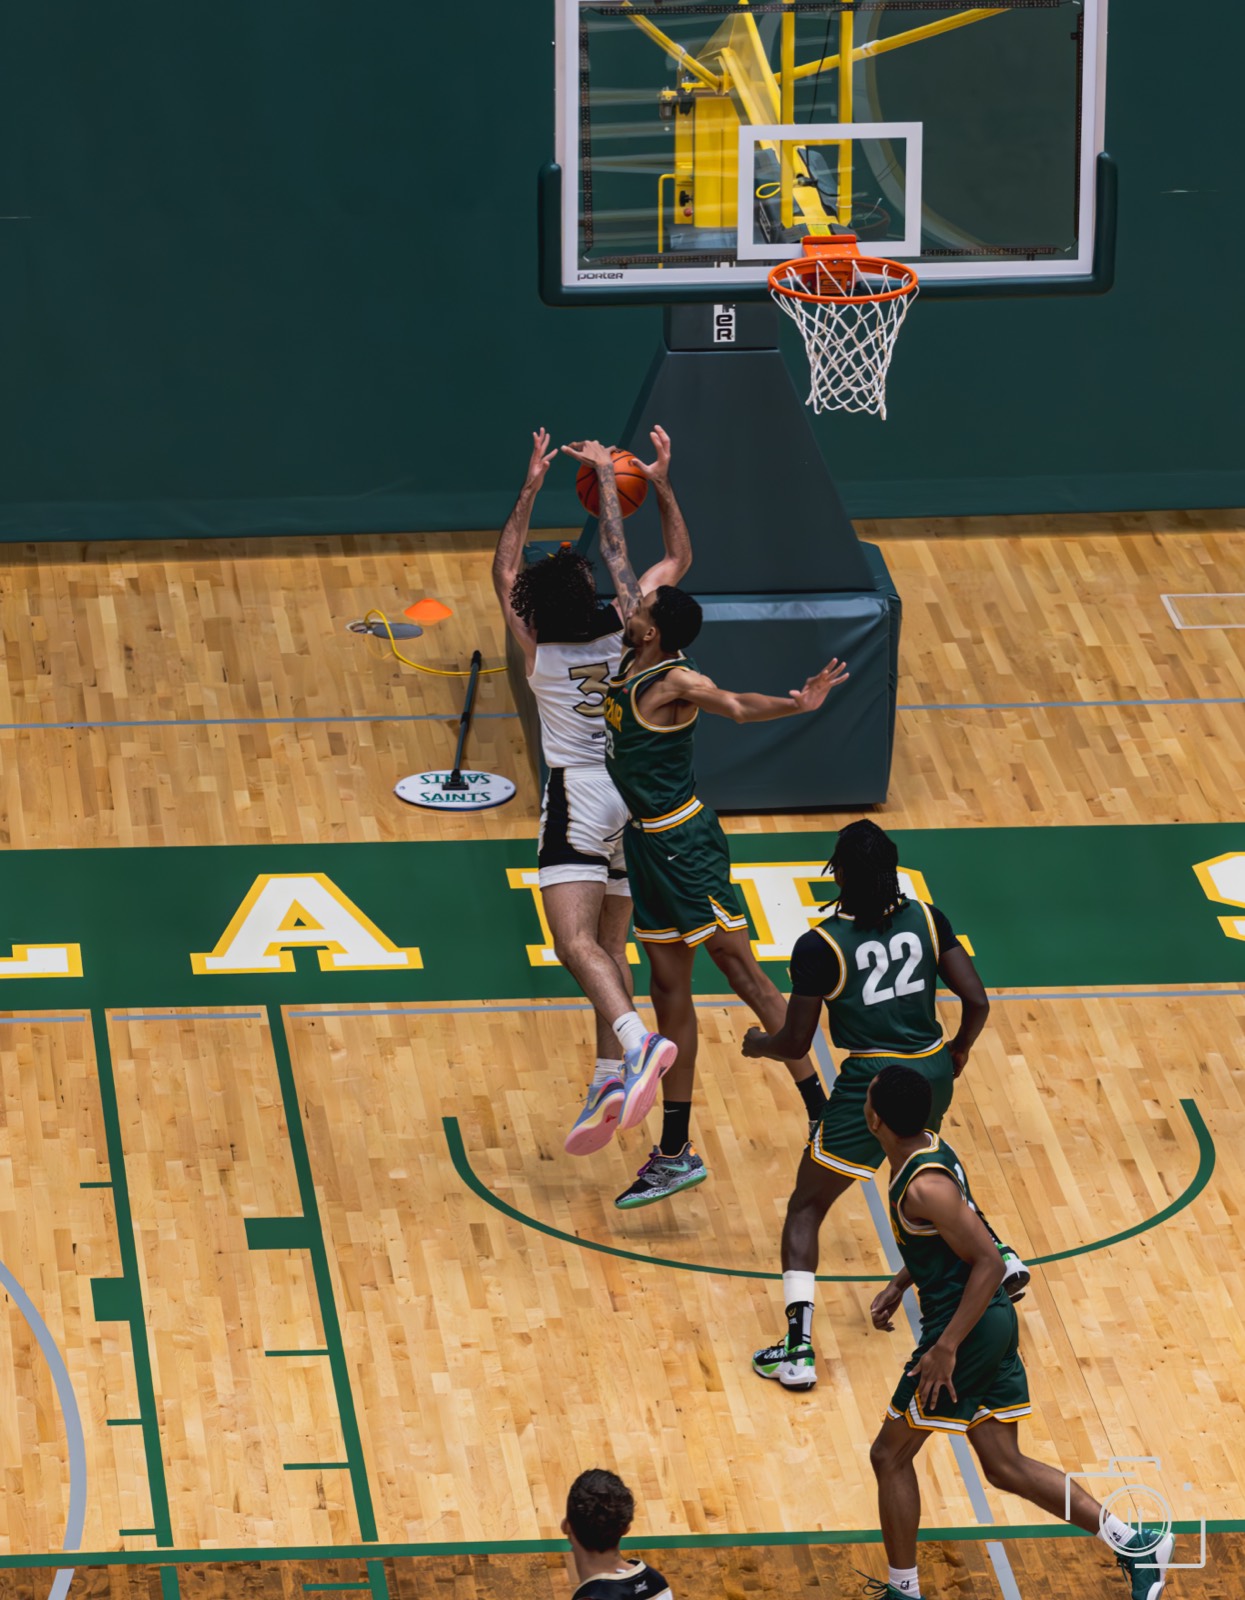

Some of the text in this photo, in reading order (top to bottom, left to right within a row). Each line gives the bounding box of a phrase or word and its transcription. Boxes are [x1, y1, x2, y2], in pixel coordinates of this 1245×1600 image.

[568, 661, 609, 718] 3
[420, 792, 491, 802] SAINTS
[855, 932, 925, 1006] 22
